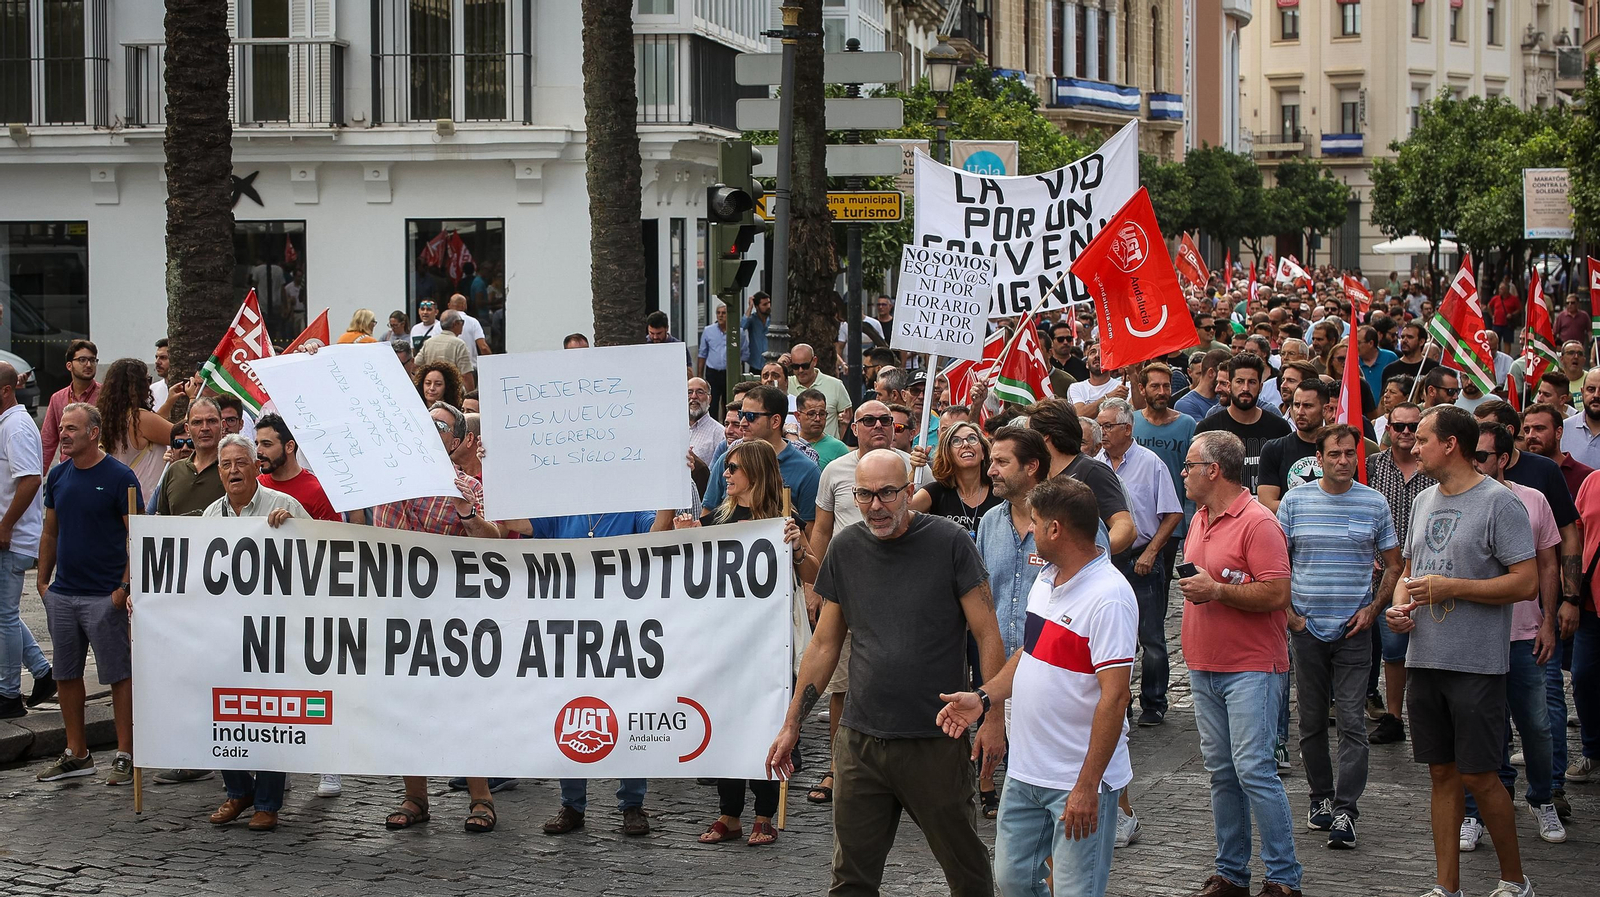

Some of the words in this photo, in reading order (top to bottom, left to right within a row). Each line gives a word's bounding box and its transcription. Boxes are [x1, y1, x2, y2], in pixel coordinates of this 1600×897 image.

[848, 195, 897, 205] municipal
[954, 172, 1005, 205] LA
[843, 206, 897, 218] turismo
[964, 207, 1036, 242] POR
[1045, 193, 1093, 232] UN
[1118, 225, 1144, 264] UGT
[904, 247, 930, 265] NO
[932, 252, 991, 272] SOMOS
[904, 260, 991, 289] ESCLAV@S,
[919, 277, 937, 292] NI
[942, 280, 974, 298] POR
[905, 293, 981, 316] HORARIO
[918, 310, 937, 325] NI
[940, 313, 972, 331] POR
[902, 323, 975, 345] SALARIO
[500, 376, 632, 405] FEDEJEREZ,
[504, 411, 545, 429] LOS
[549, 402, 635, 424] NUEVOS
[530, 427, 616, 446] NEGREROS
[383, 454, 399, 469] EL
[414, 436, 436, 465] 250
[529, 453, 560, 471] DEL
[322, 442, 363, 495] MUCHA
[141, 536, 190, 594] MI
[202, 536, 439, 599] CONVENIO
[451, 550, 511, 599] ES
[522, 552, 577, 599] MI
[591, 538, 778, 600] FUTURO
[243, 615, 286, 674] NI
[304, 616, 368, 676] UN
[384, 618, 502, 677] PASO
[516, 618, 664, 679] ATRAS
[219, 694, 302, 717] CCOO
[562, 707, 611, 735] UGT
[628, 711, 687, 731] FITAG
[212, 722, 307, 745] industria
[212, 745, 249, 758] Cádiz
